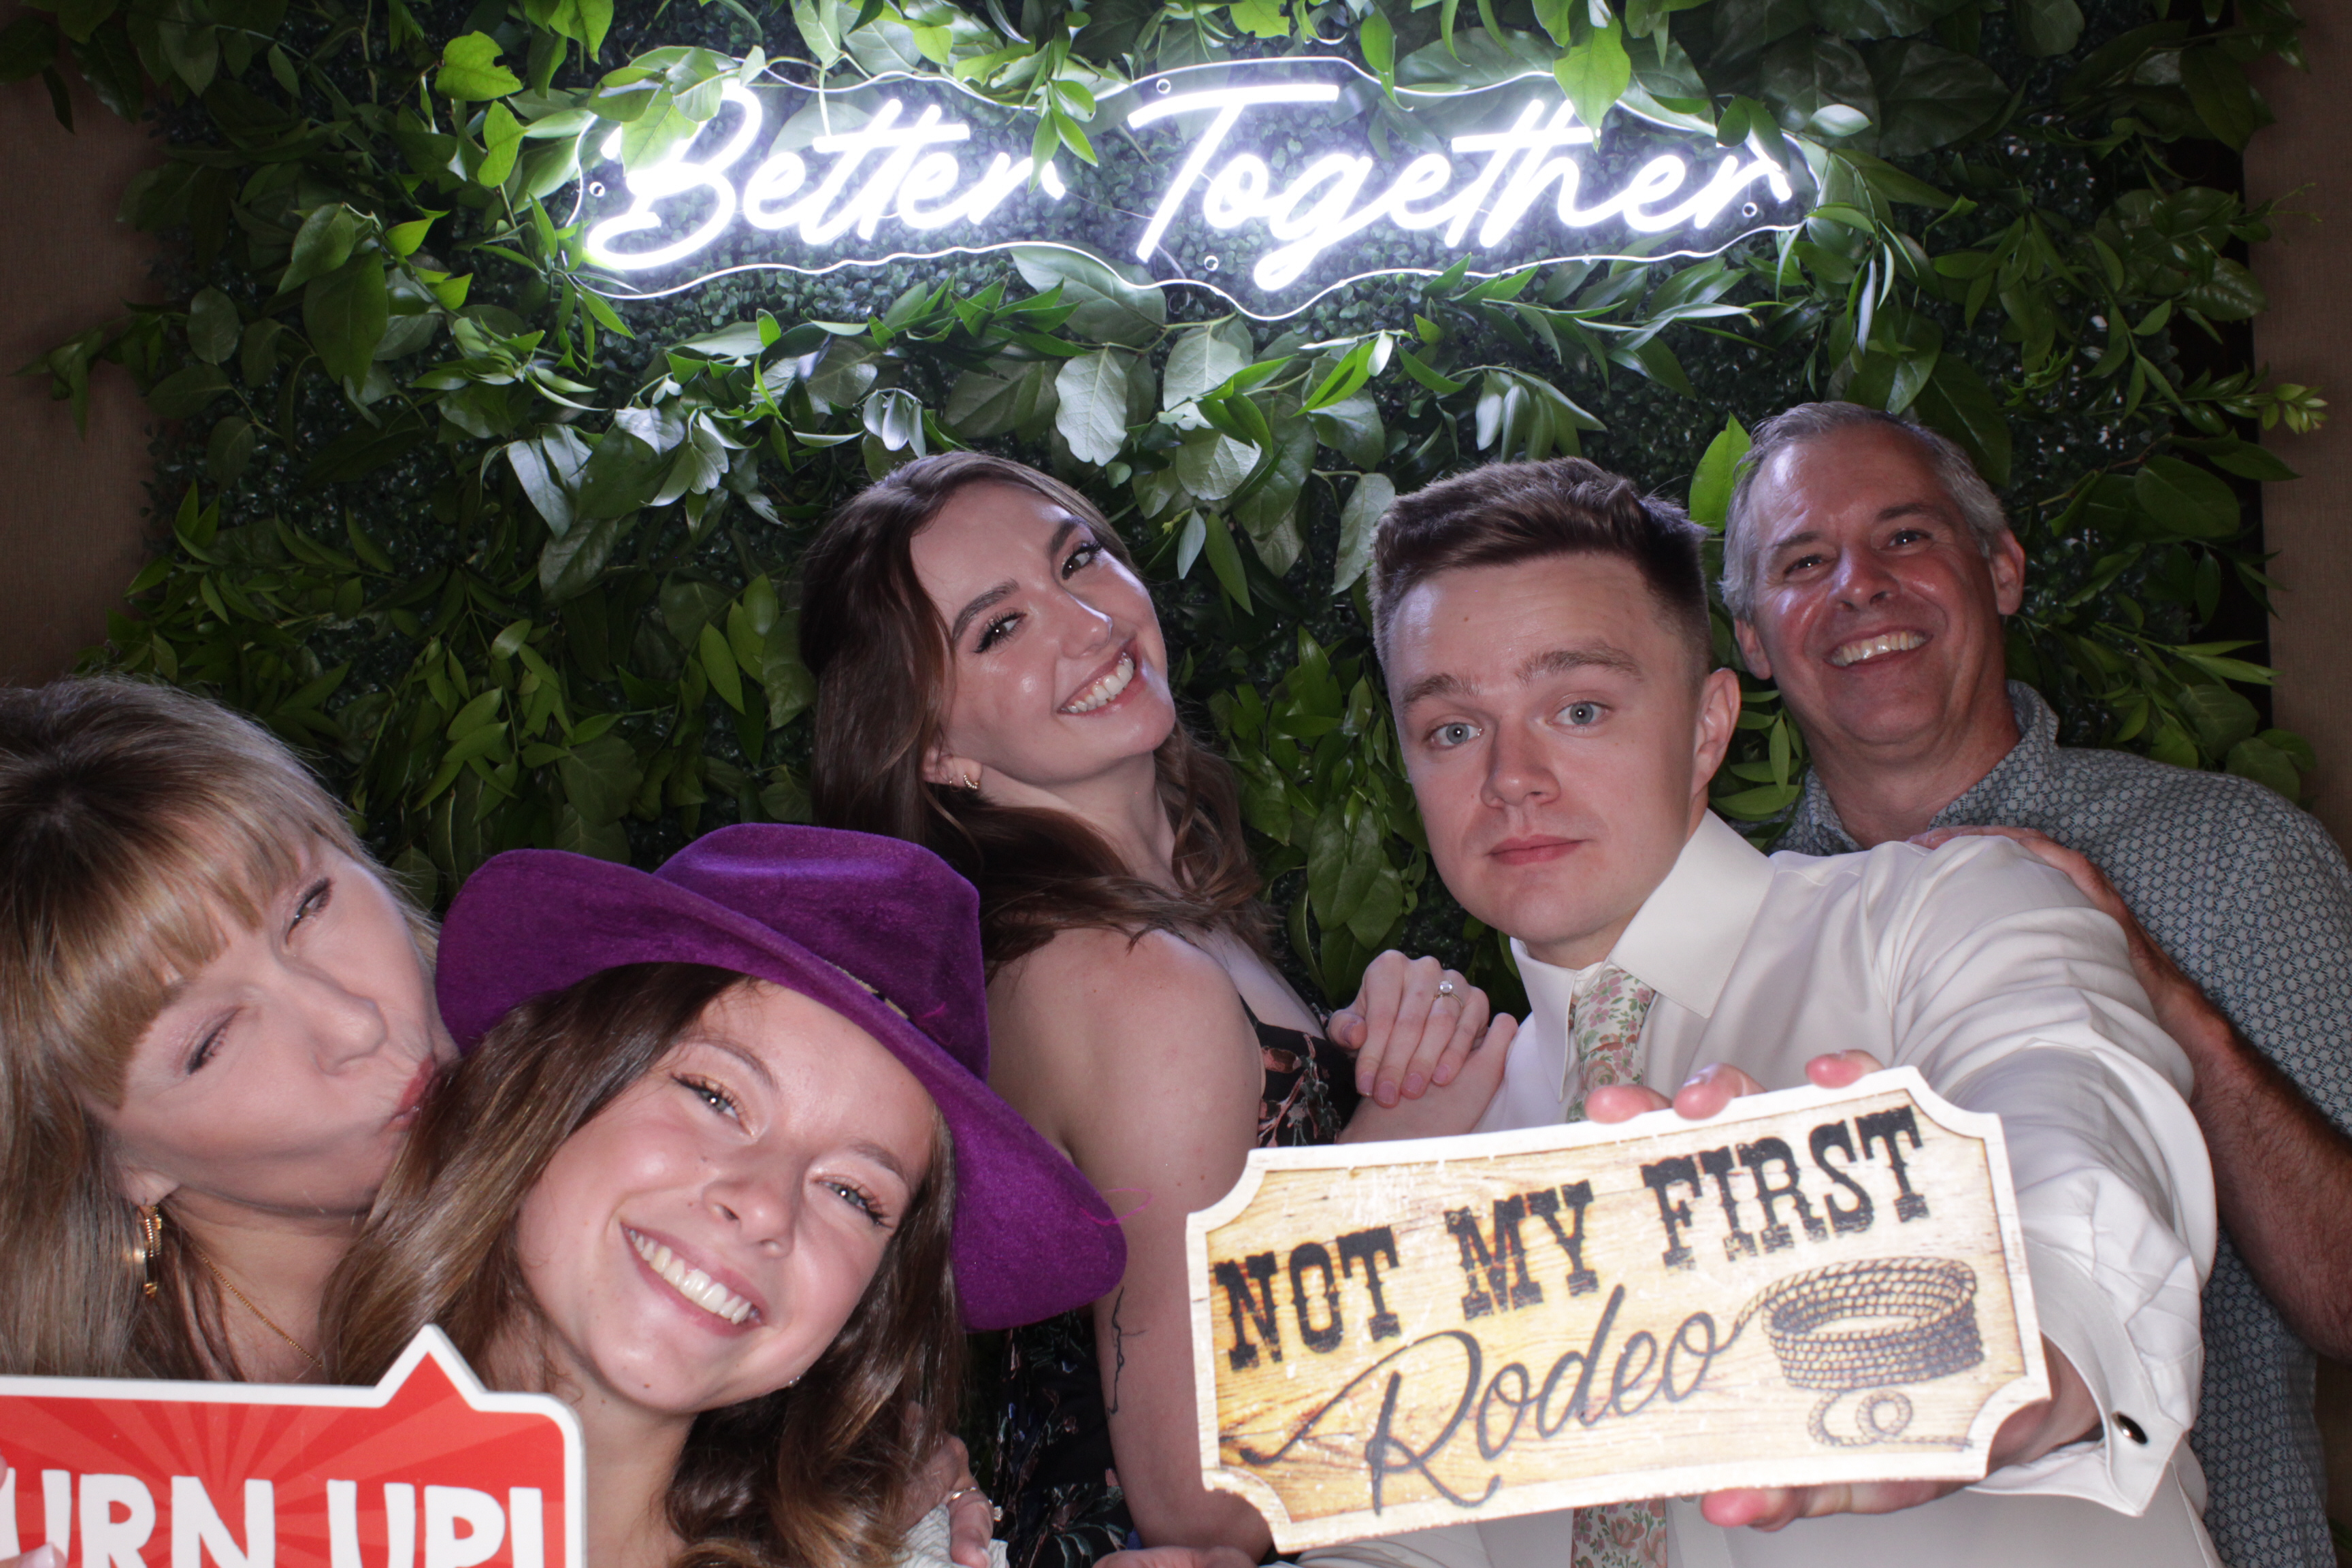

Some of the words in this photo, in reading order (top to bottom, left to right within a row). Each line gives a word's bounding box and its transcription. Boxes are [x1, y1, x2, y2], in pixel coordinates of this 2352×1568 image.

[587, 79, 1066, 270] Better
[1128, 84, 1793, 291] Together
[1213, 1226, 1402, 1371] NOT
[1443, 1179, 1599, 1321] MY
[1639, 1105, 1931, 1271] FIRST
[1239, 1283, 1744, 1517] Rodeo
